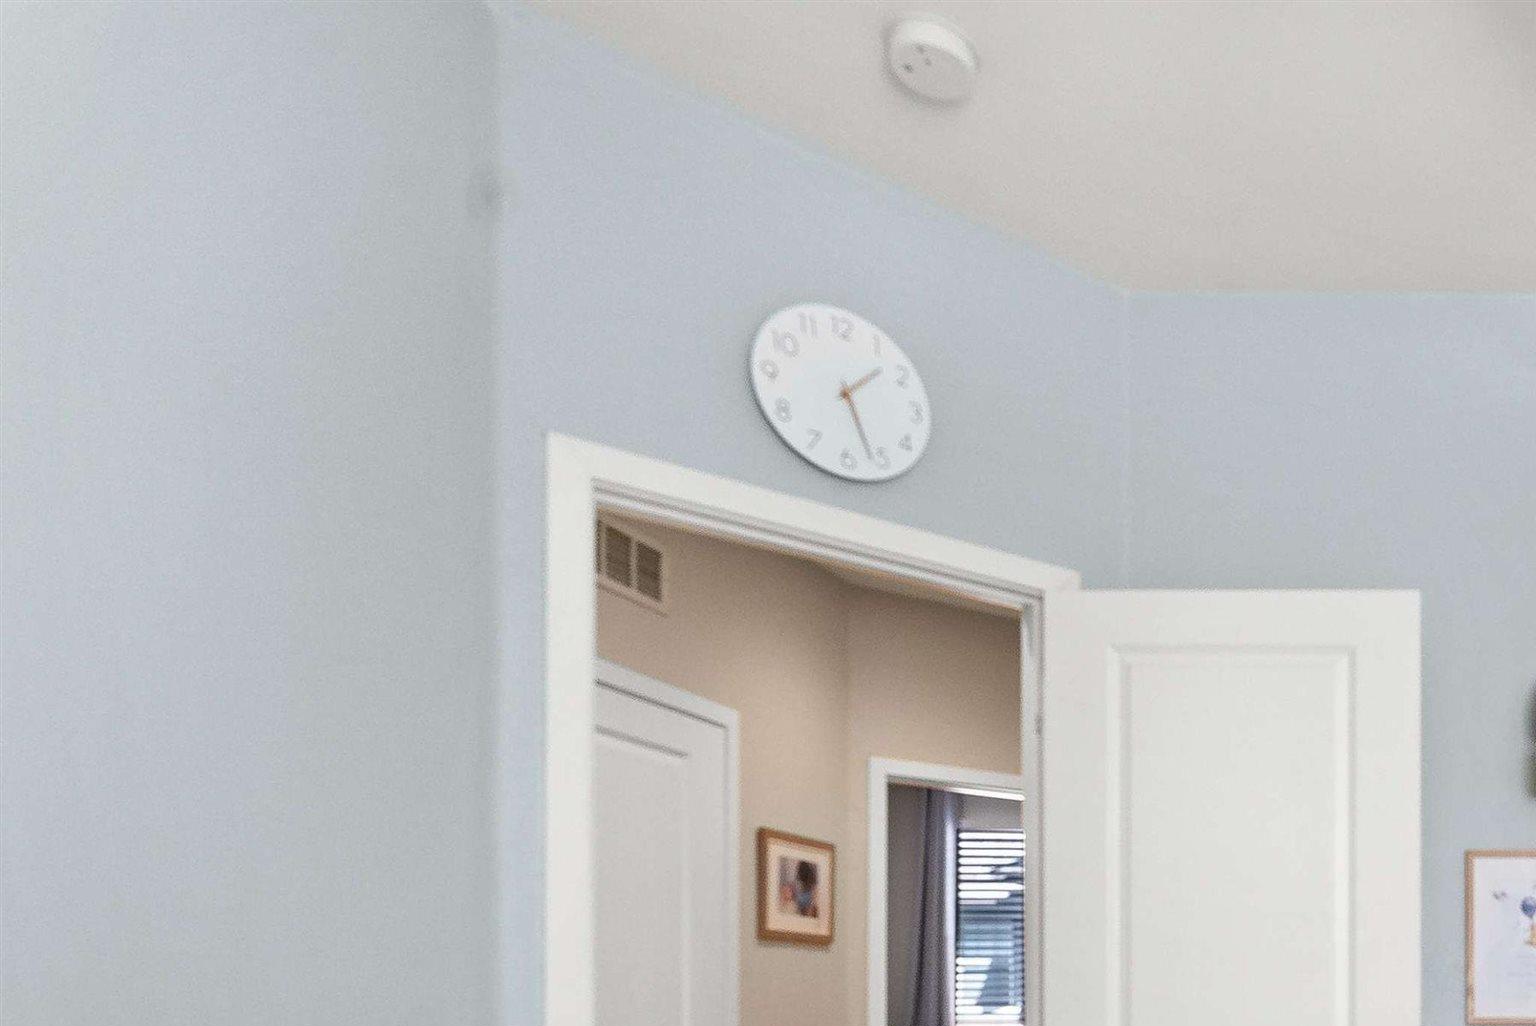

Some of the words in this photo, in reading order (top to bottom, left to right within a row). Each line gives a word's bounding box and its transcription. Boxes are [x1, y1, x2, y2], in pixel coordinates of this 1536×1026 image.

[799, 312, 819, 339] 11
[831, 314, 855, 342] 12
[771, 330, 799, 358] 10
[872, 333, 882, 358] 1
[760, 359, 780, 382] 9
[897, 364, 910, 389] 2
[774, 397, 792, 423] 8
[908, 400, 923, 425] 3
[806, 428, 823, 450] 7
[839, 448, 858, 471] 6
[875, 446, 891, 470] 5
